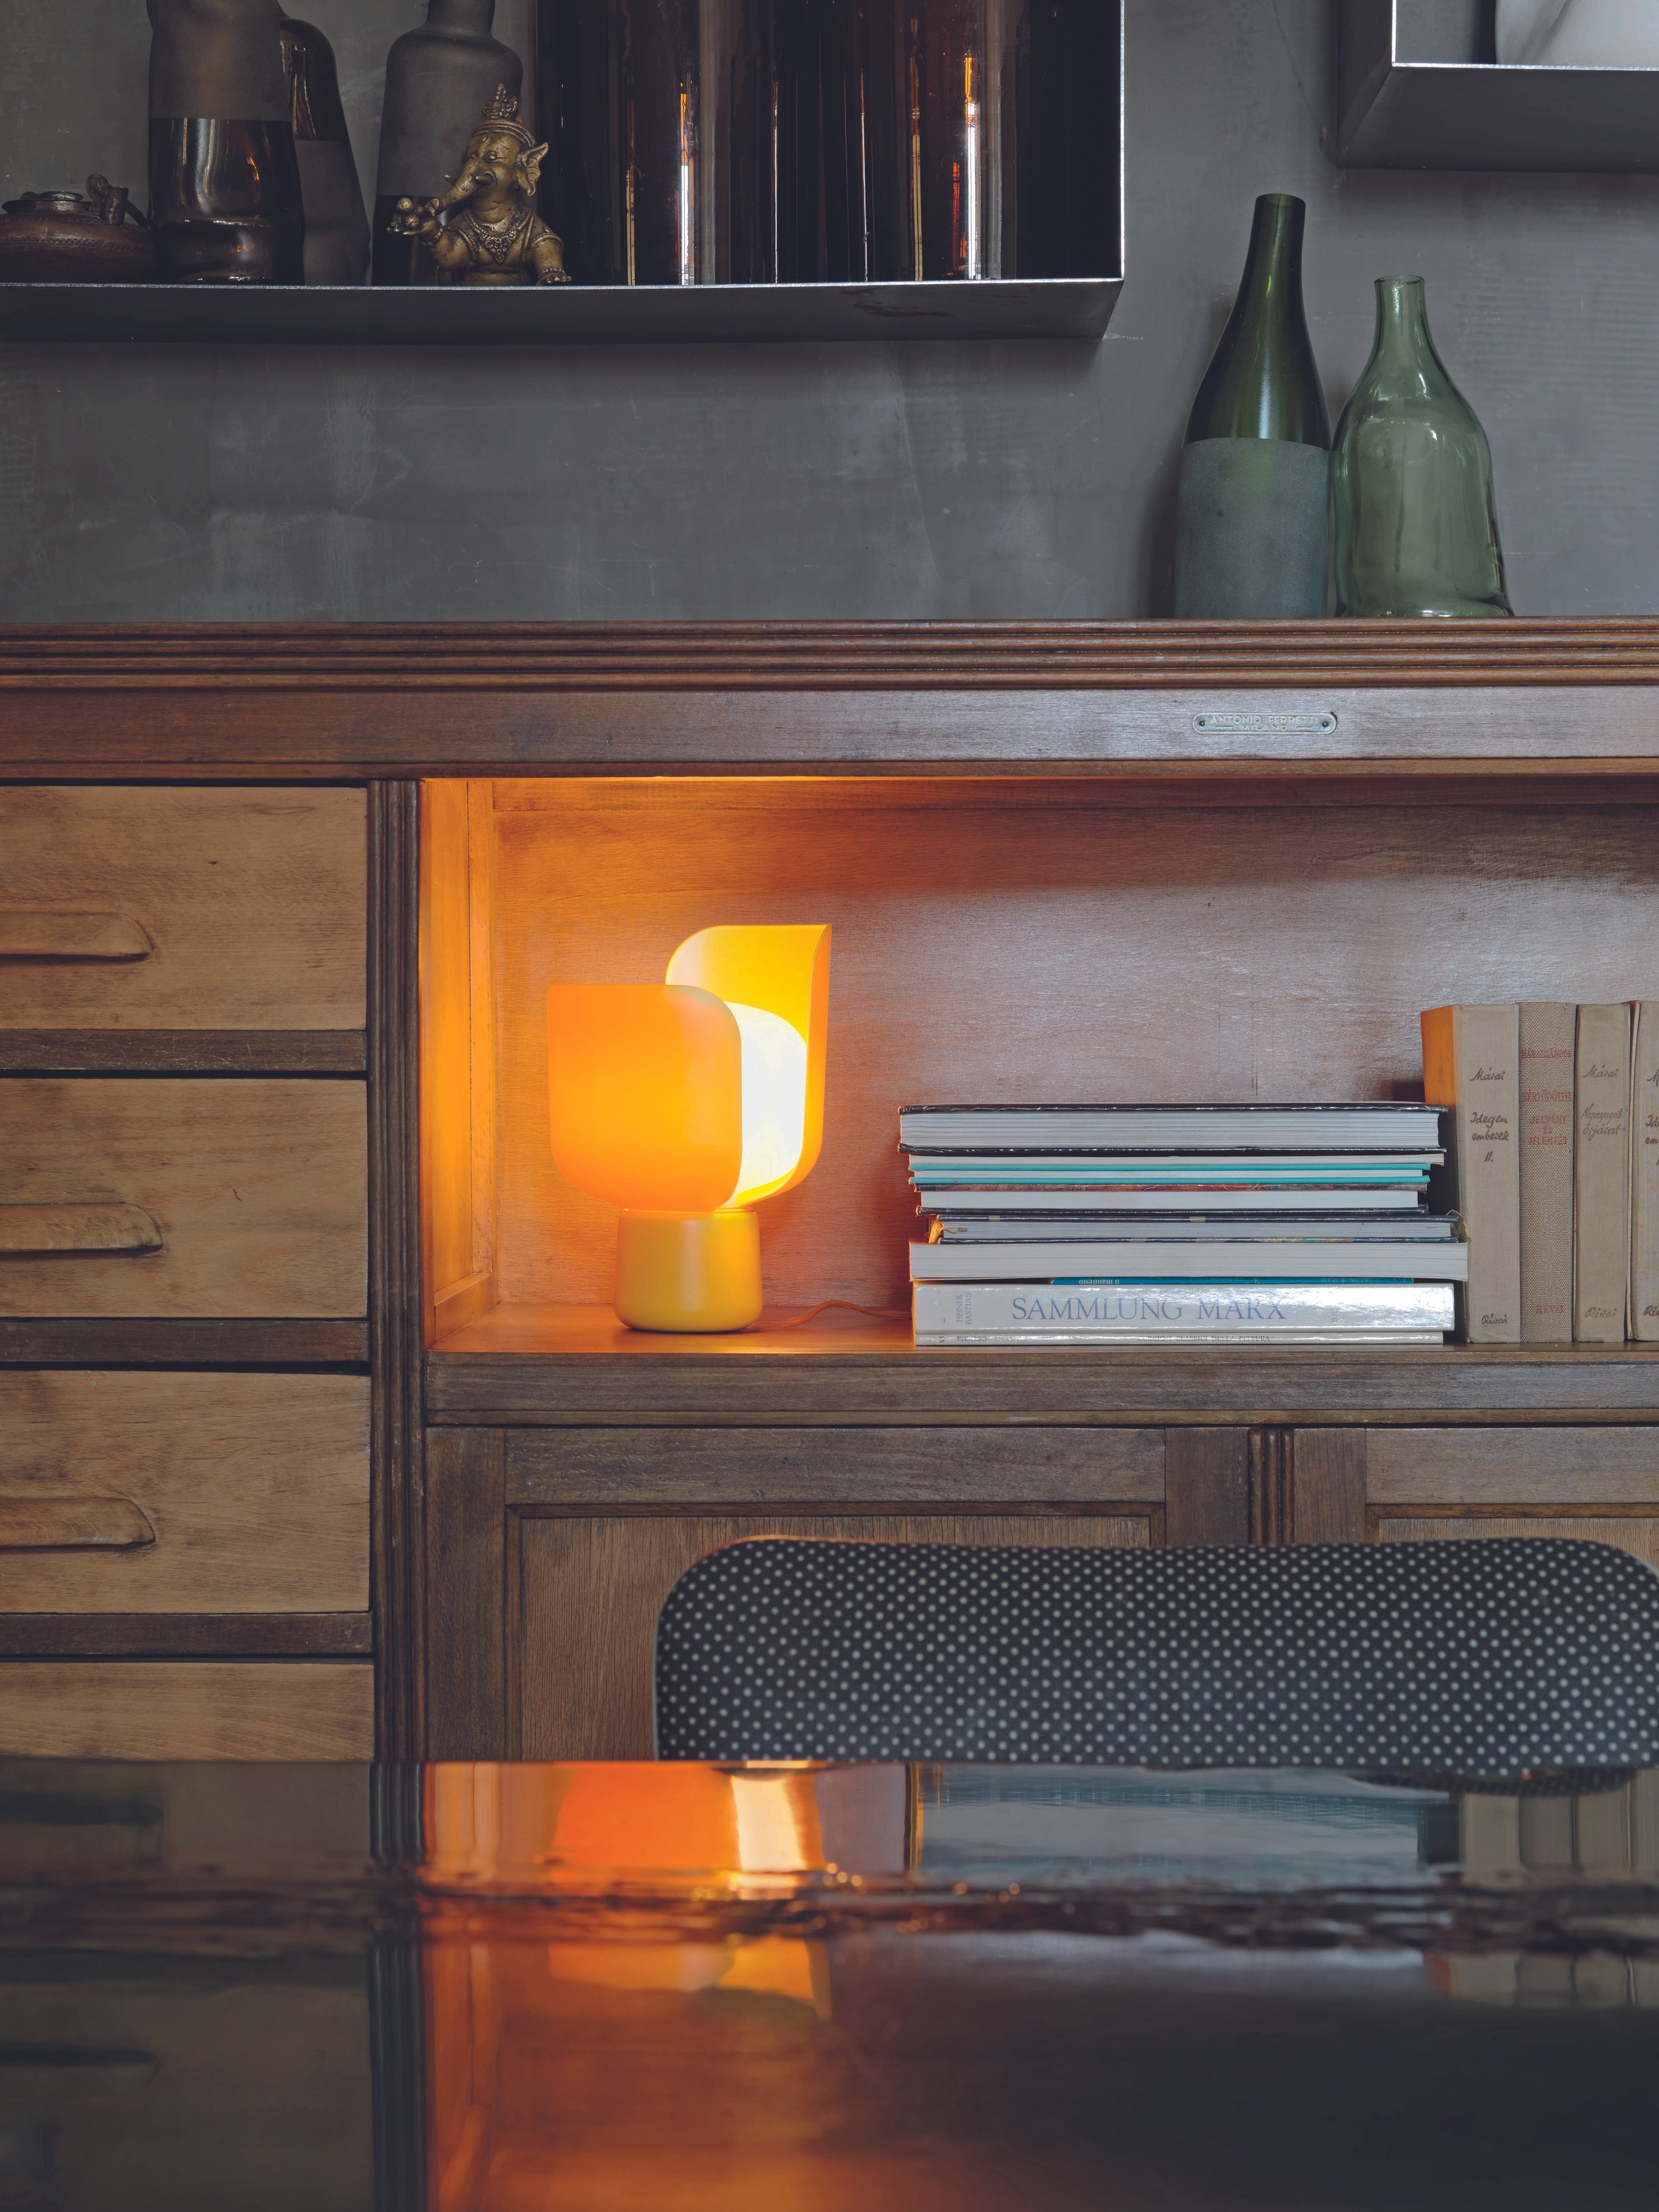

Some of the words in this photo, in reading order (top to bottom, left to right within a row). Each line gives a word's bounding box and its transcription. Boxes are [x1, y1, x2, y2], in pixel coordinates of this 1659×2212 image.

[1210, 715, 1262, 724] ANTONIO
[1267, 715, 1319, 724] FERRETTI
[1469, 1067, 1506, 1081] Márai
[1582, 1065, 1619, 1078] Márai
[1470, 1112, 1508, 1128] Idegen
[1472, 1130, 1510, 1142] emberek
[1012, 1297, 1183, 1321] SAMMLUNG
[1197, 1298, 1287, 1320] MARX
[1481, 1313, 1508, 1325] Révai
